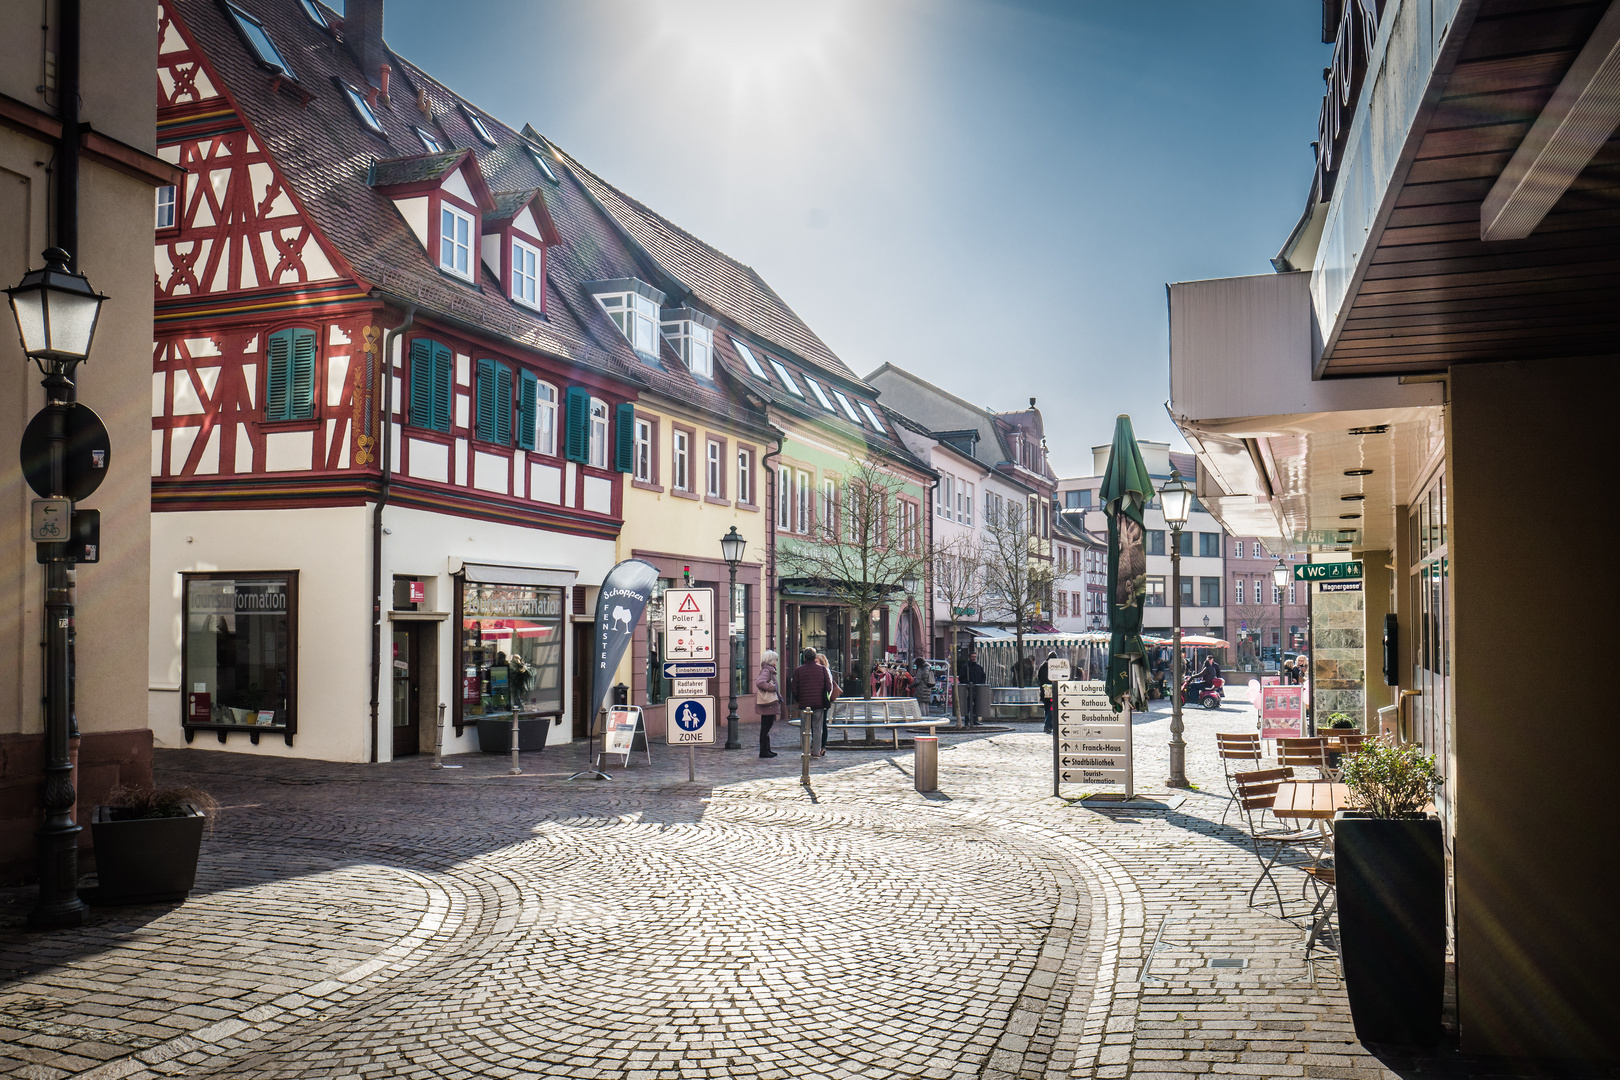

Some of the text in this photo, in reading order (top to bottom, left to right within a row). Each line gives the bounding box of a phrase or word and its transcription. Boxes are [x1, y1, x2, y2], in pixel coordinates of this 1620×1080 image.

[1307, 566, 1326, 577] WC
[1322, 583, 1360, 591] Wagnergasse
[603, 587, 644, 602] Schoppen
[672, 614, 694, 622] Poller
[600, 604, 609, 669] FENSTER
[1081, 699, 1107, 707] Rathaus
[1081, 713, 1120, 722] Busbahnhof
[679, 733, 703, 742] ZONE
[1082, 743, 1122, 752] Franck-Haus
[1071, 757, 1115, 766] Stadtbibliothek
